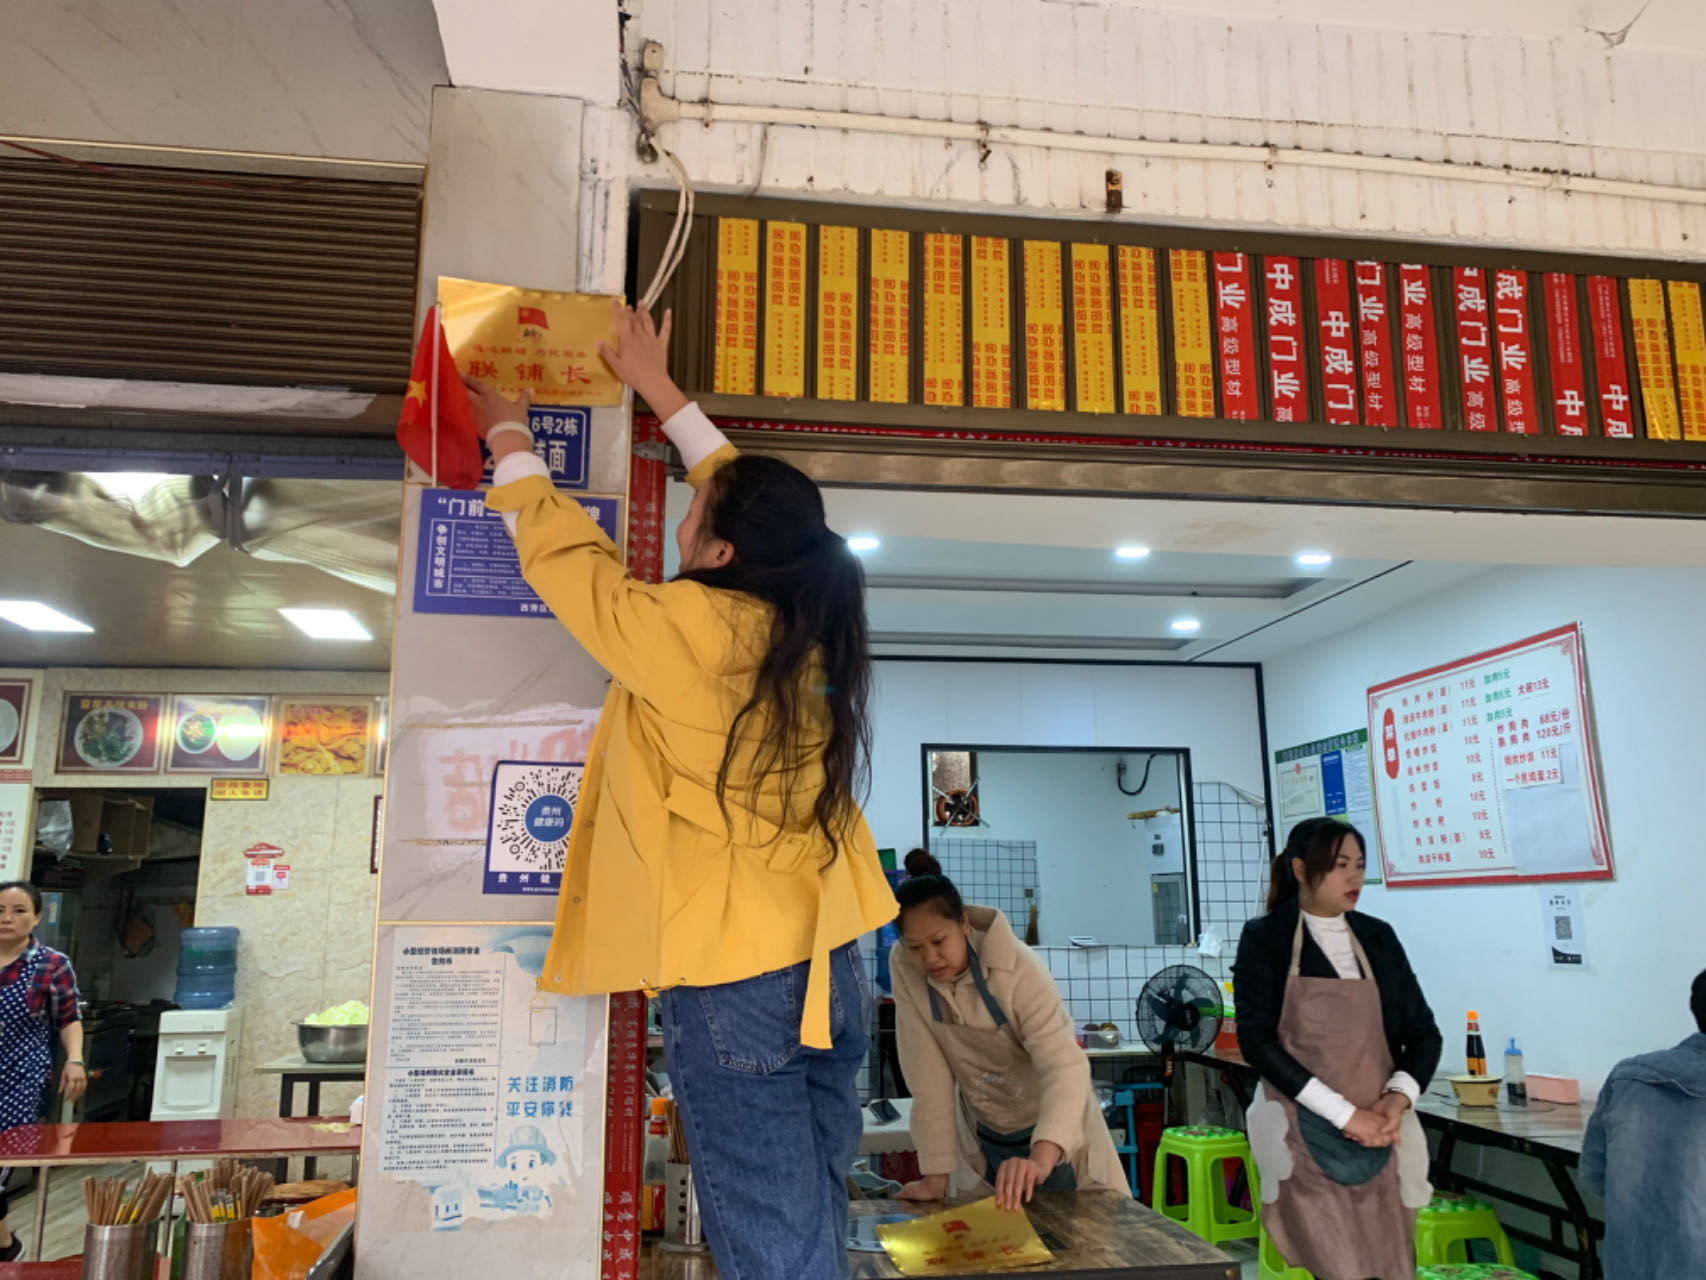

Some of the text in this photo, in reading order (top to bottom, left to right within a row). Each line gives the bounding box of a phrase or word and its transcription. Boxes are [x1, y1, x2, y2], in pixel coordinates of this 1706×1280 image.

[1267, 263, 1300, 399] 中成门业
[1321, 311, 1354, 425] 中成门
[528, 416, 579, 437] 6号2栋
[507, 1076, 574, 1093] 关注消防
